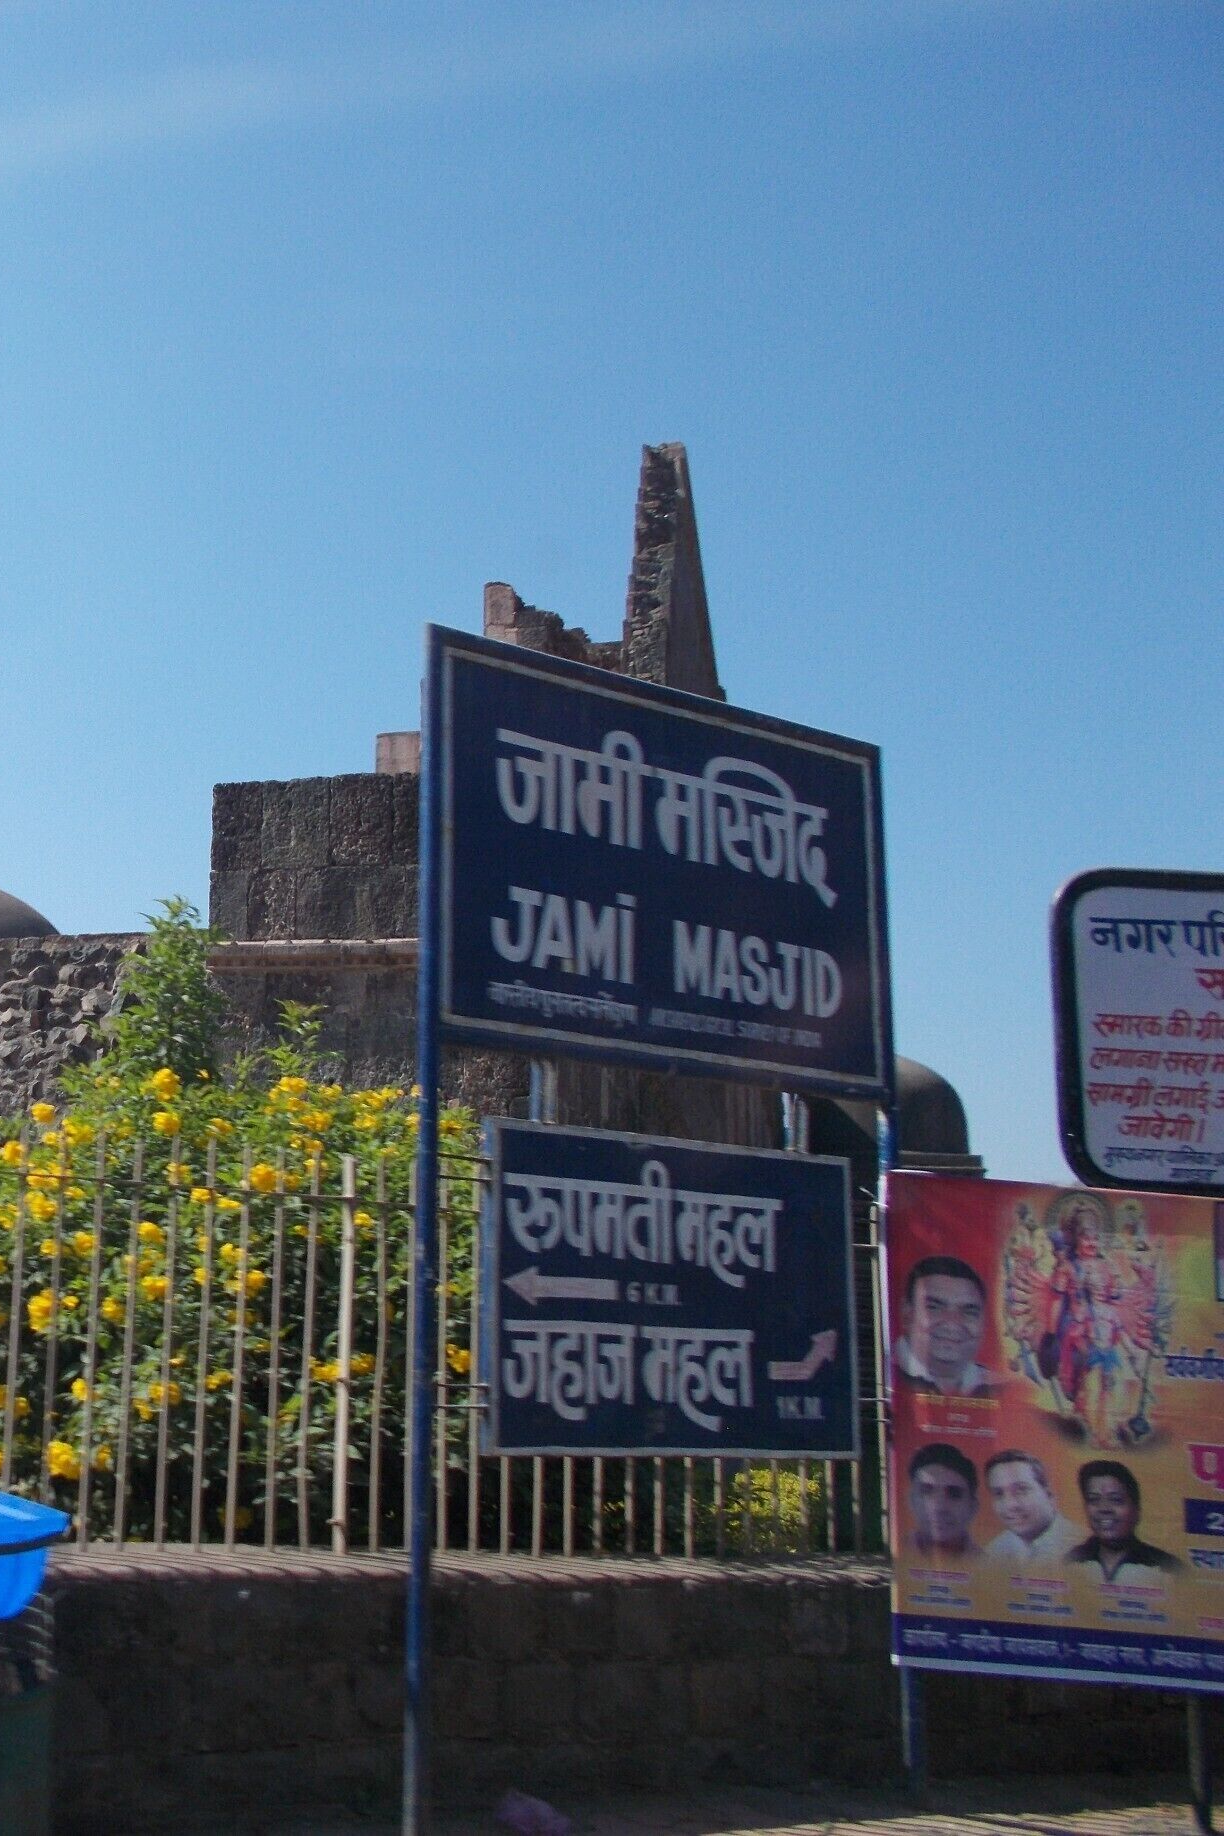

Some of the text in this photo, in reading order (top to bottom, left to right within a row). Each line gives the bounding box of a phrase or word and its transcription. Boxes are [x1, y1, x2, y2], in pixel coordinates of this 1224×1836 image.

[495, 727, 839, 909] जामी मस्जिद
[673, 918, 843, 1019] MASJID
[1088, 916, 1176, 959] नगर
[1166, 1008, 1192, 1038] की
[672, 1187, 784, 1290] महल
[503, 1318, 755, 1433] जहाज महल
